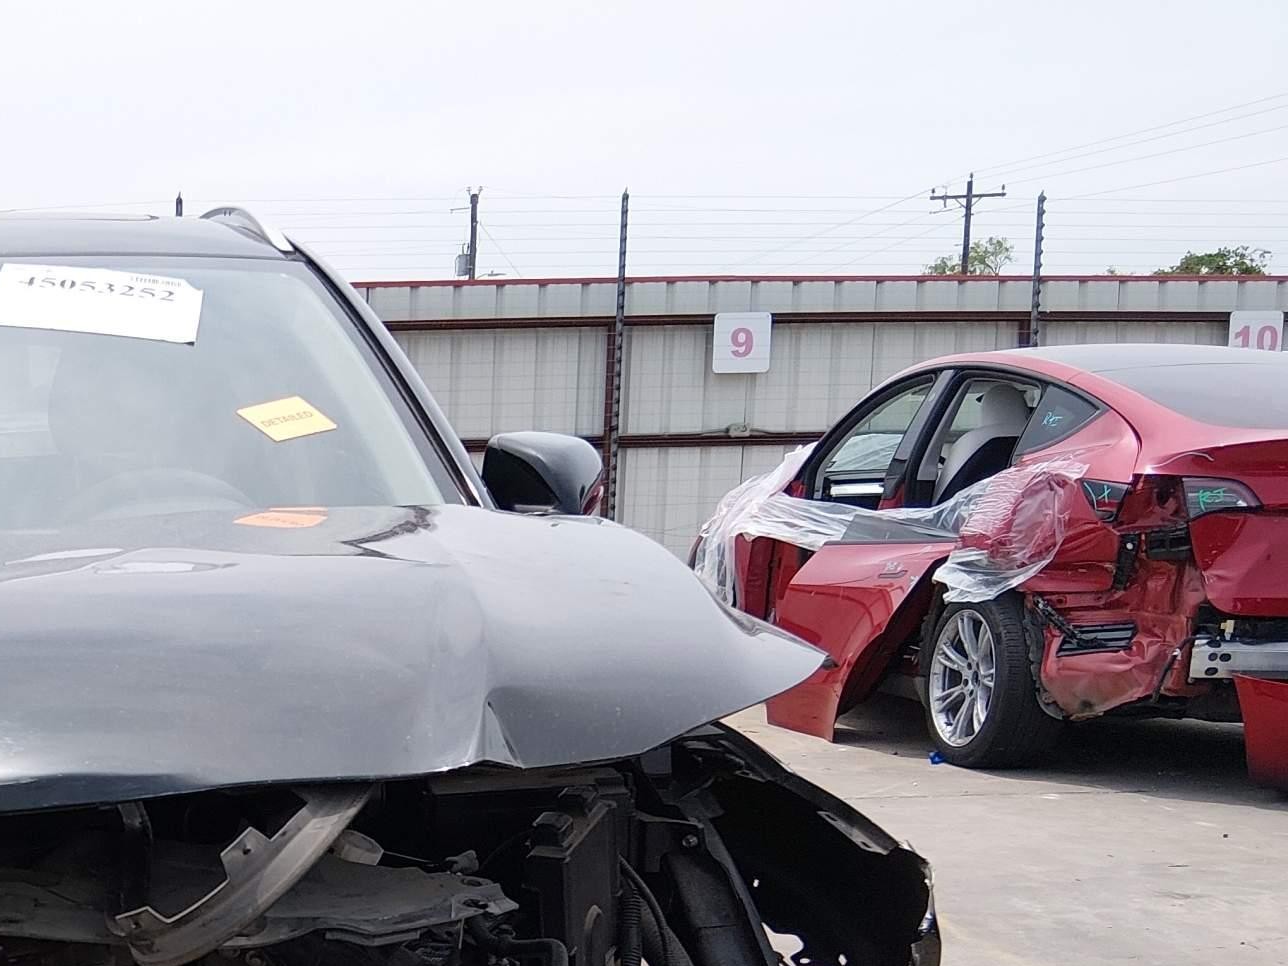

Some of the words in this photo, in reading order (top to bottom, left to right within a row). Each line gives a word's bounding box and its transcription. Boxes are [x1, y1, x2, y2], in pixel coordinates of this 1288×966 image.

[18, 276, 176, 302] 45053252
[731, 328, 754, 358] 9
[1234, 325, 1278, 350] 10
[260, 411, 314, 428] DETAILED
